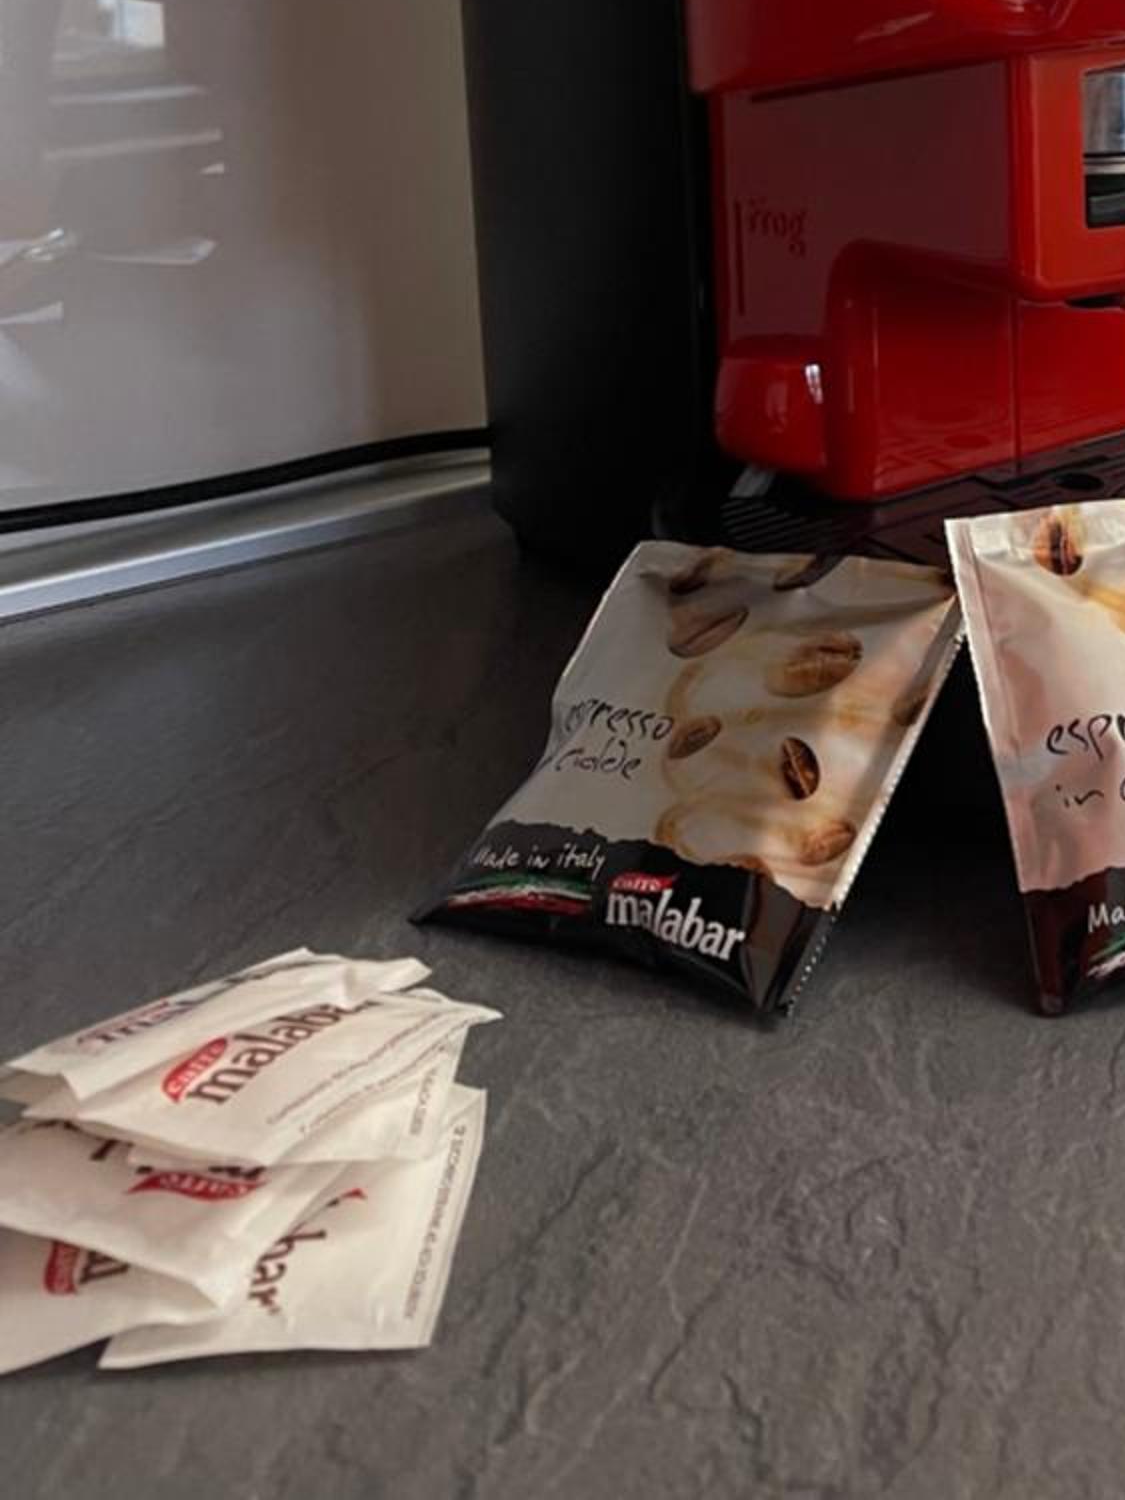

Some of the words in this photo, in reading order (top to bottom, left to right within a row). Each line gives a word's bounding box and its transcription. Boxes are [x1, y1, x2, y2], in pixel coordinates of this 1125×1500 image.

[1056, 786, 1104, 810] in
[527, 843, 551, 869] in
[556, 842, 607, 883] italy
[604, 887, 747, 964] malabar
